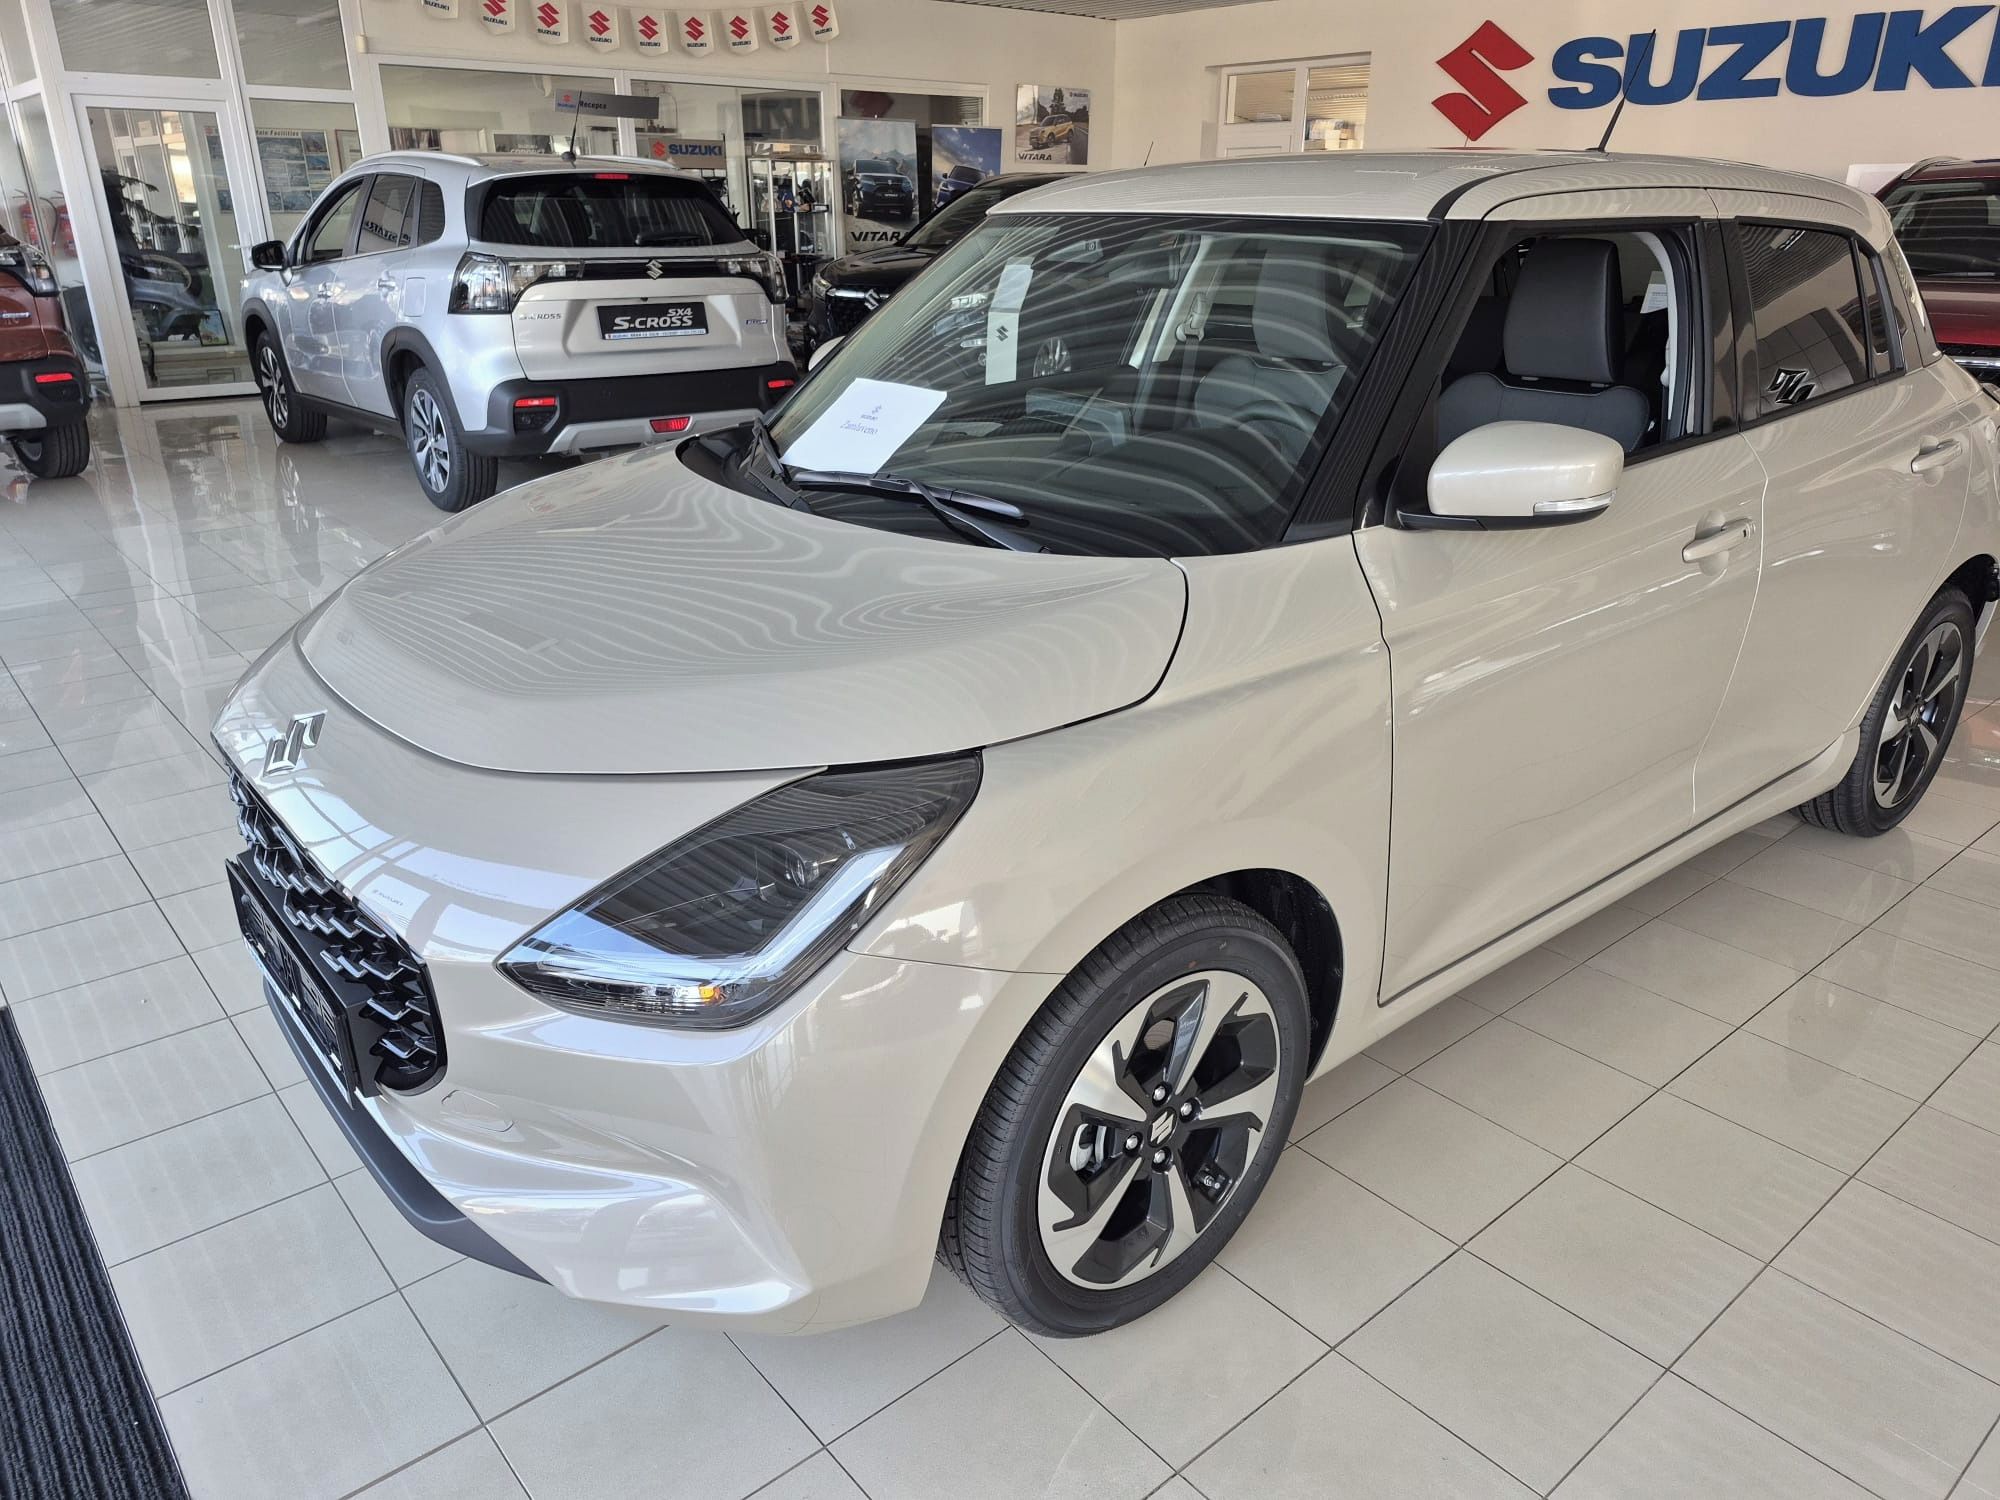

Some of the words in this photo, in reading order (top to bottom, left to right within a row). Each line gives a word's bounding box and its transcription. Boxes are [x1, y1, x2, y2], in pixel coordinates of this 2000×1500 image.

[483, 16, 507, 25] SUZUKI
[537, 28, 560, 36] SUZUKI
[668, 143, 722, 156] SUZUKI
[1018, 153, 1052, 161] VITARA
[850, 231, 909, 242] VITAR
[667, 307, 693, 317] SX4
[612, 315, 693, 330] S-CROSS
